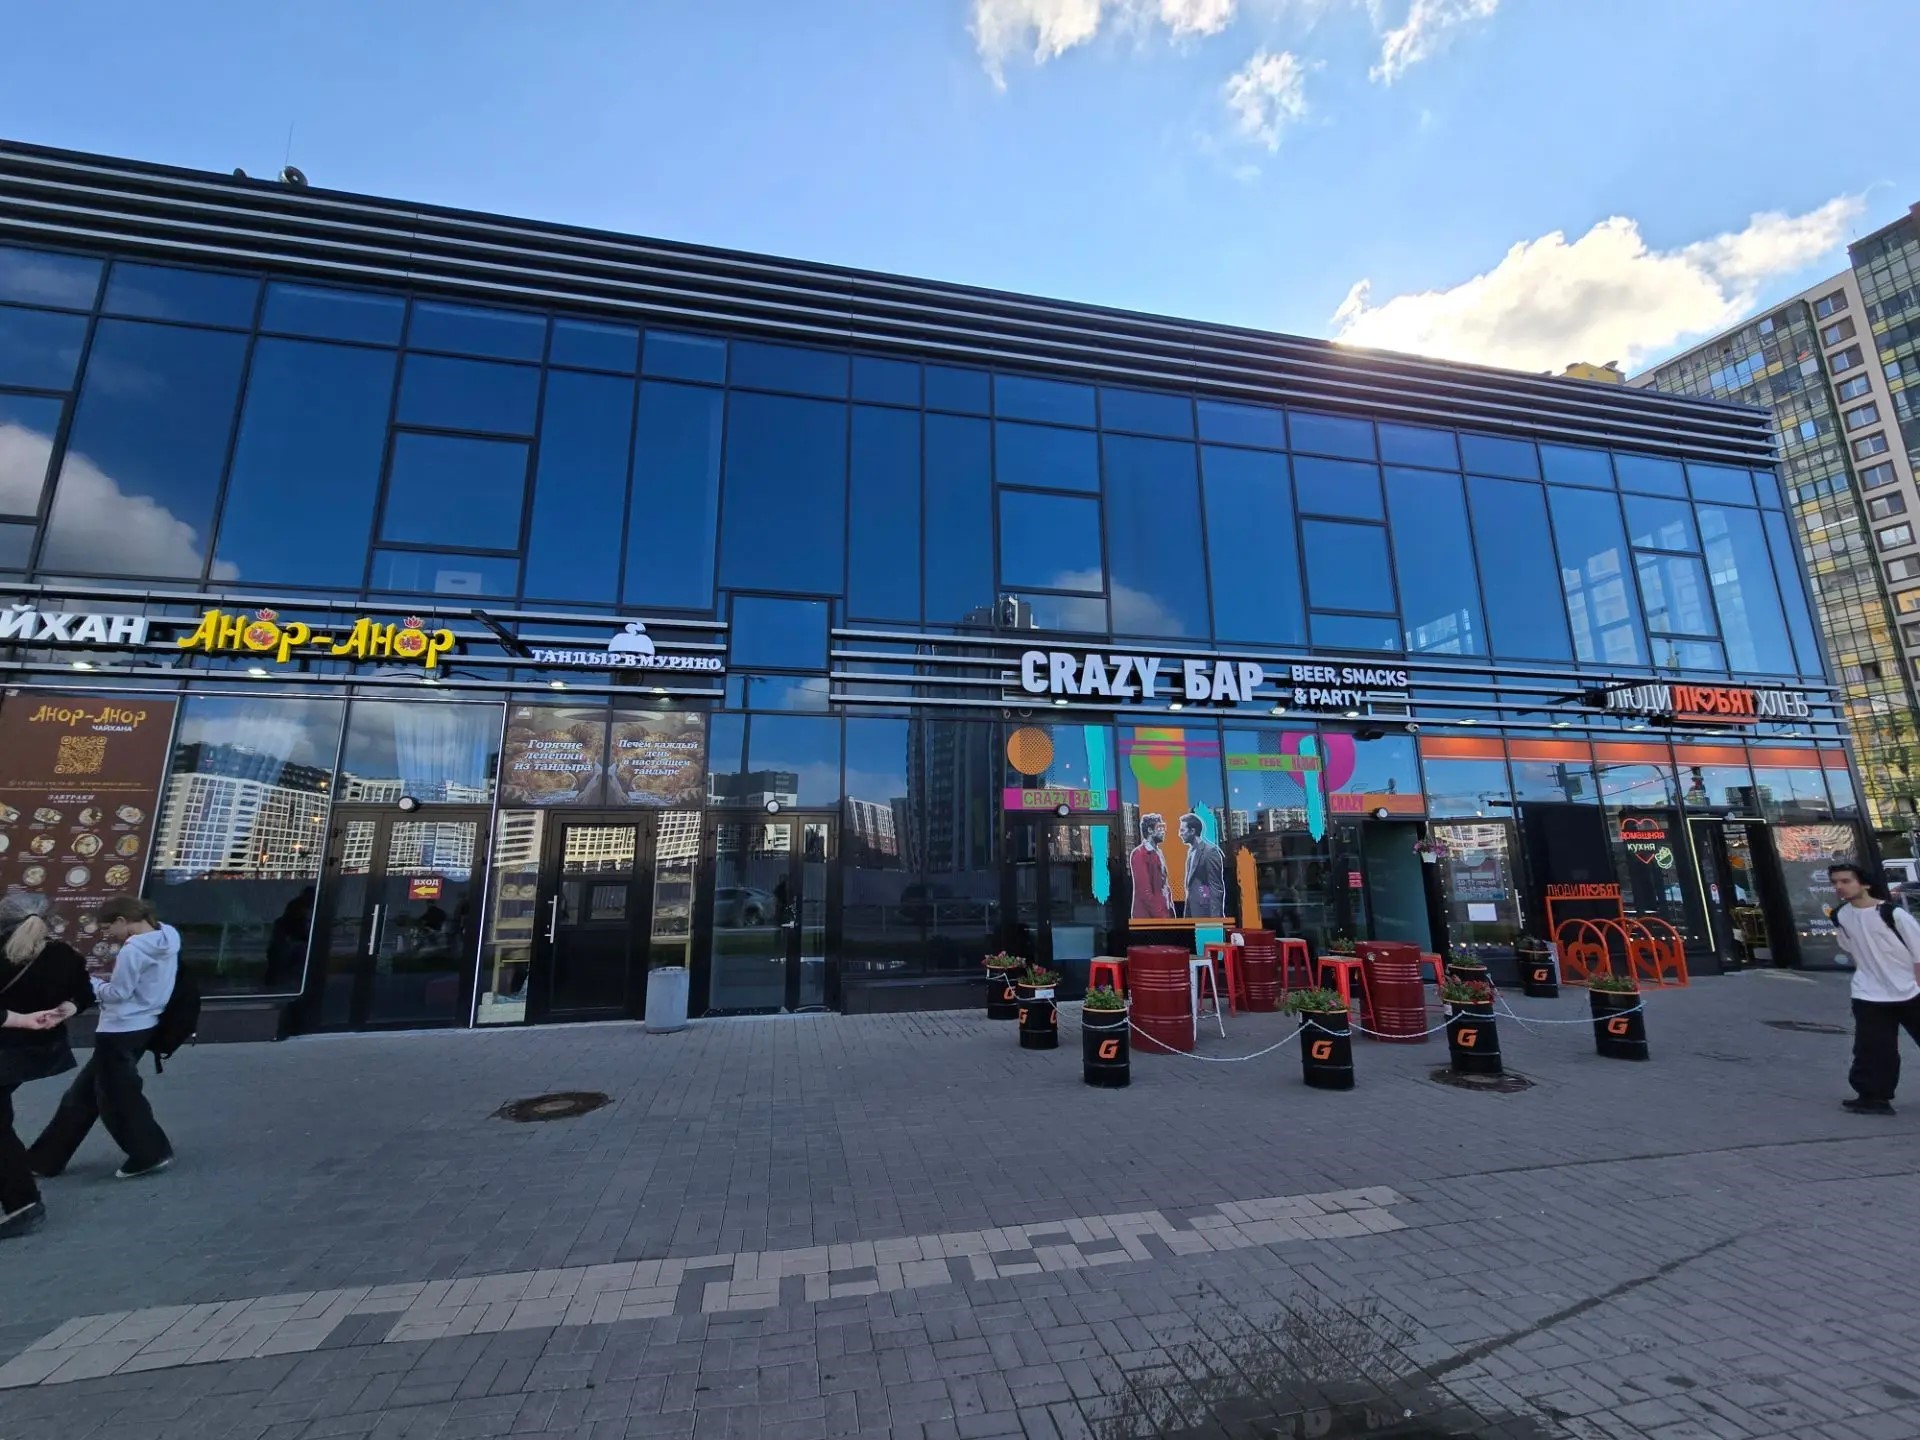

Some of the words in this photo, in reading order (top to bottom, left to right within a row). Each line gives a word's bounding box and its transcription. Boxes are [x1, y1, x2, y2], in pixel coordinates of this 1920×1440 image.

[1021, 650, 1162, 699] CRAZY
[1183, 658, 1265, 702] БАР
[1291, 664, 1341, 687] BEER,
[1343, 667, 1409, 688] SNACKS
[1294, 687, 1308, 705] &
[1310, 688, 1362, 707] PARTY
[1606, 683, 1673, 714] ЛЮДИ
[1756, 689, 1810, 718] ХЛЕБ
[528, 739, 583, 751] Горячие
[514, 762, 530, 770] из
[533, 763, 592, 772] тандыра
[632, 759, 690, 767] настоящем
[634, 768, 680, 777] тандыре
[1023, 791, 1070, 806] CRAZY
[1607, 1017, 1630, 1035] G
[1457, 1028, 1478, 1048] G
[1099, 1039, 1120, 1059] G
[1311, 1040, 1334, 1060] G
